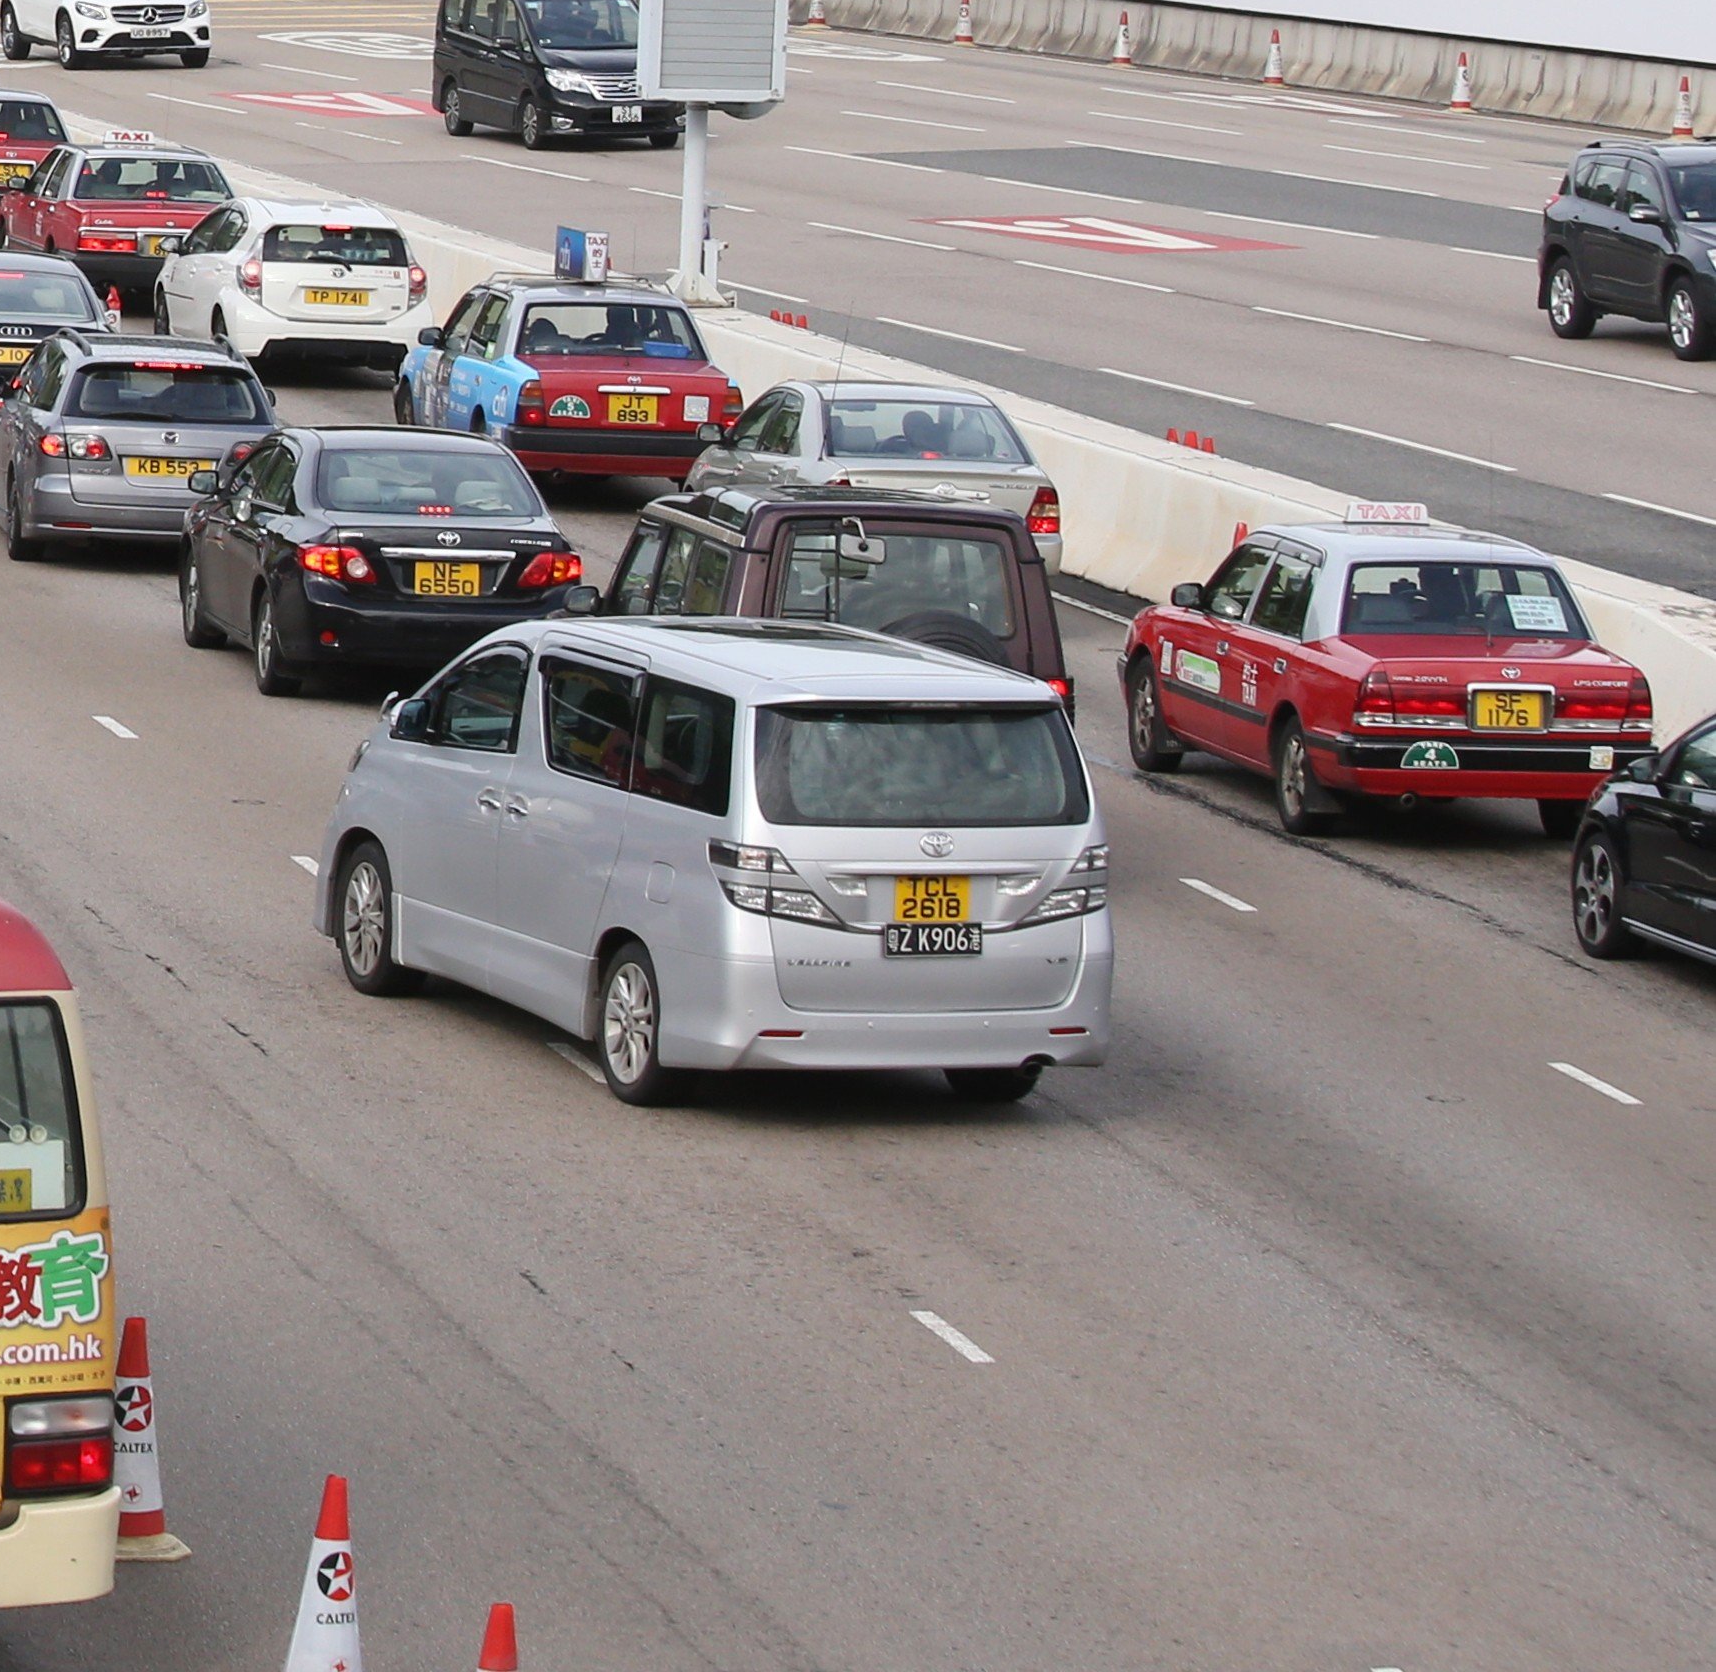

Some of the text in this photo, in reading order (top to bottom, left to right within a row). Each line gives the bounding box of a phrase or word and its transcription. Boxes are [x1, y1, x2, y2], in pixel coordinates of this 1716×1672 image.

[110, 131, 151, 144] TAXI
[587, 236, 608, 246] TAXI
[311, 290, 363, 304] TP 1741
[622, 395, 643, 409] JT
[617, 408, 649, 423] 893
[138, 459, 161, 474] KB
[1356, 504, 1421, 521] TAXI
[433, 563, 461, 579] NF
[419, 579, 474, 594] 6550
[1495, 694, 1523, 709] SF
[1488, 709, 1528, 726] 1176
[1425, 748, 1436, 760] 4
[908, 877, 957, 897] TCL
[903, 898, 961, 918] 2618
